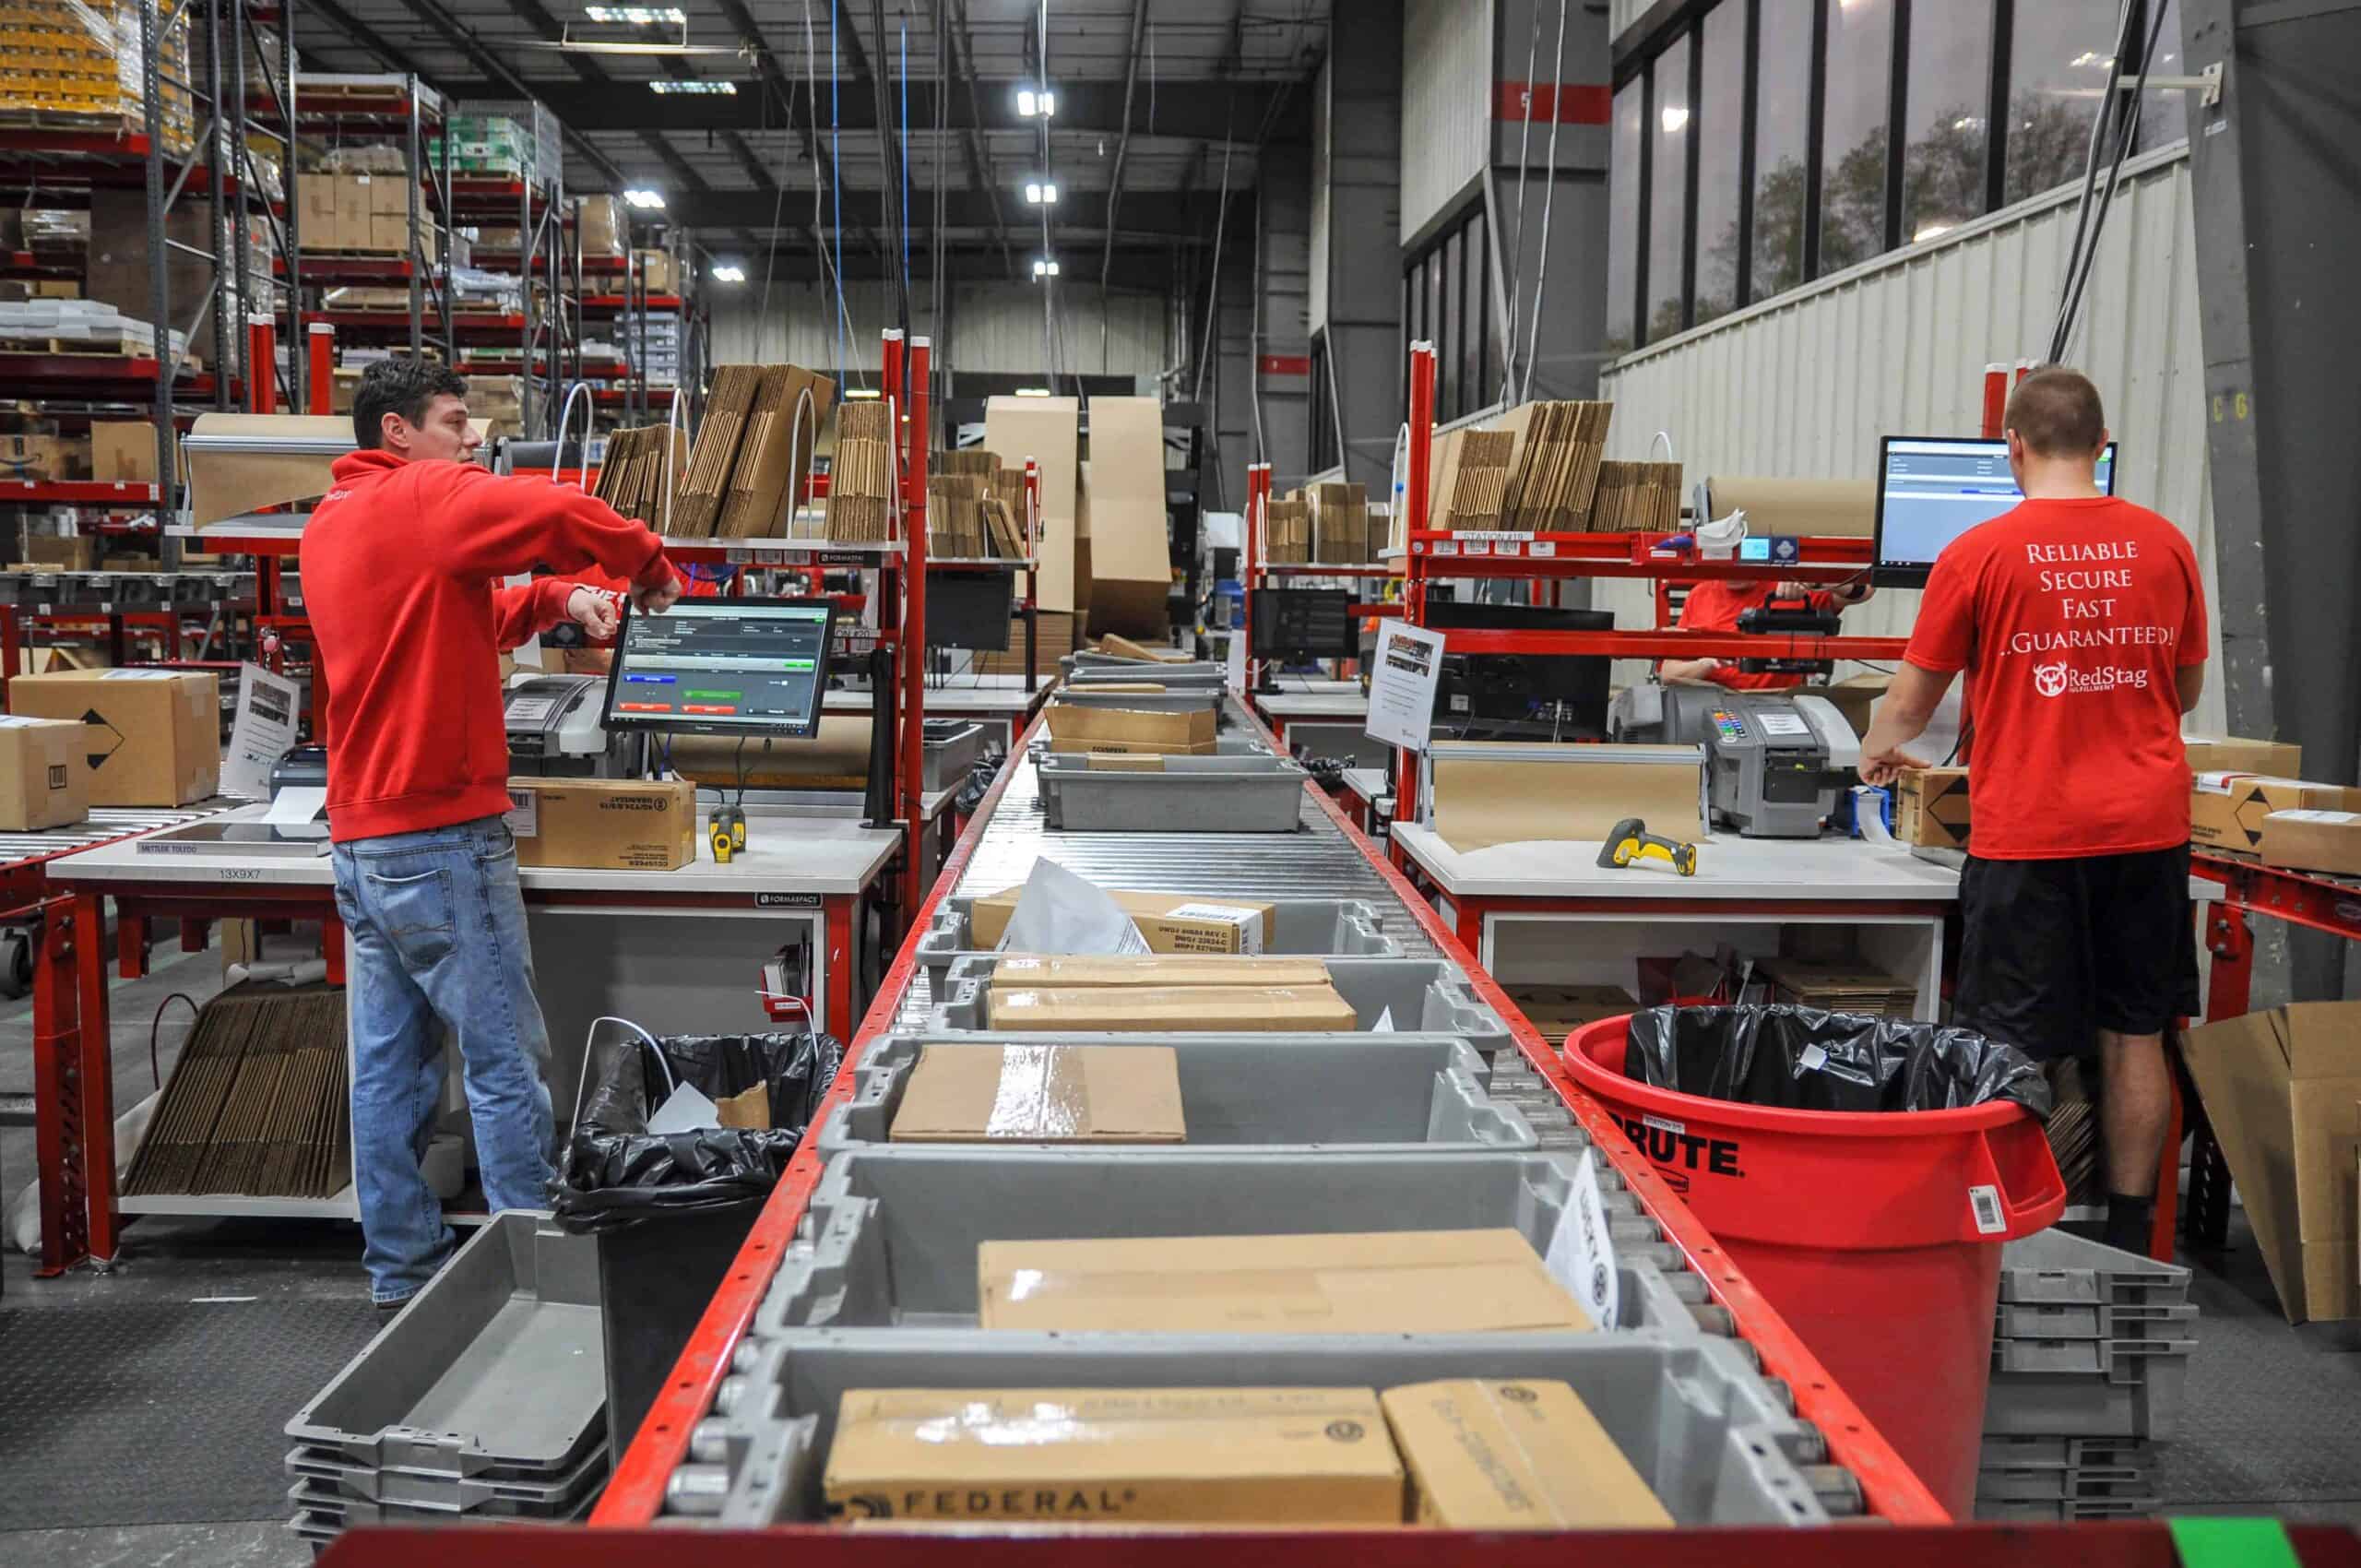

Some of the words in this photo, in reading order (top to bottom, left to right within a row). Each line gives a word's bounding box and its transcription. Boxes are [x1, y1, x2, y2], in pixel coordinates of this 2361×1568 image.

[1464, 531, 1505, 540] STATION
[2024, 540, 2139, 564] RELIABLE
[2039, 568, 2133, 592] SECURE
[2062, 598, 2117, 620] FAST
[2069, 666, 2148, 688] RedStag
[141, 844, 170, 853] METTLER
[172, 845, 197, 854] TOLEDO
[220, 869, 260, 879] 13X9X7
[1609, 1111, 1745, 1179] RUTE.
